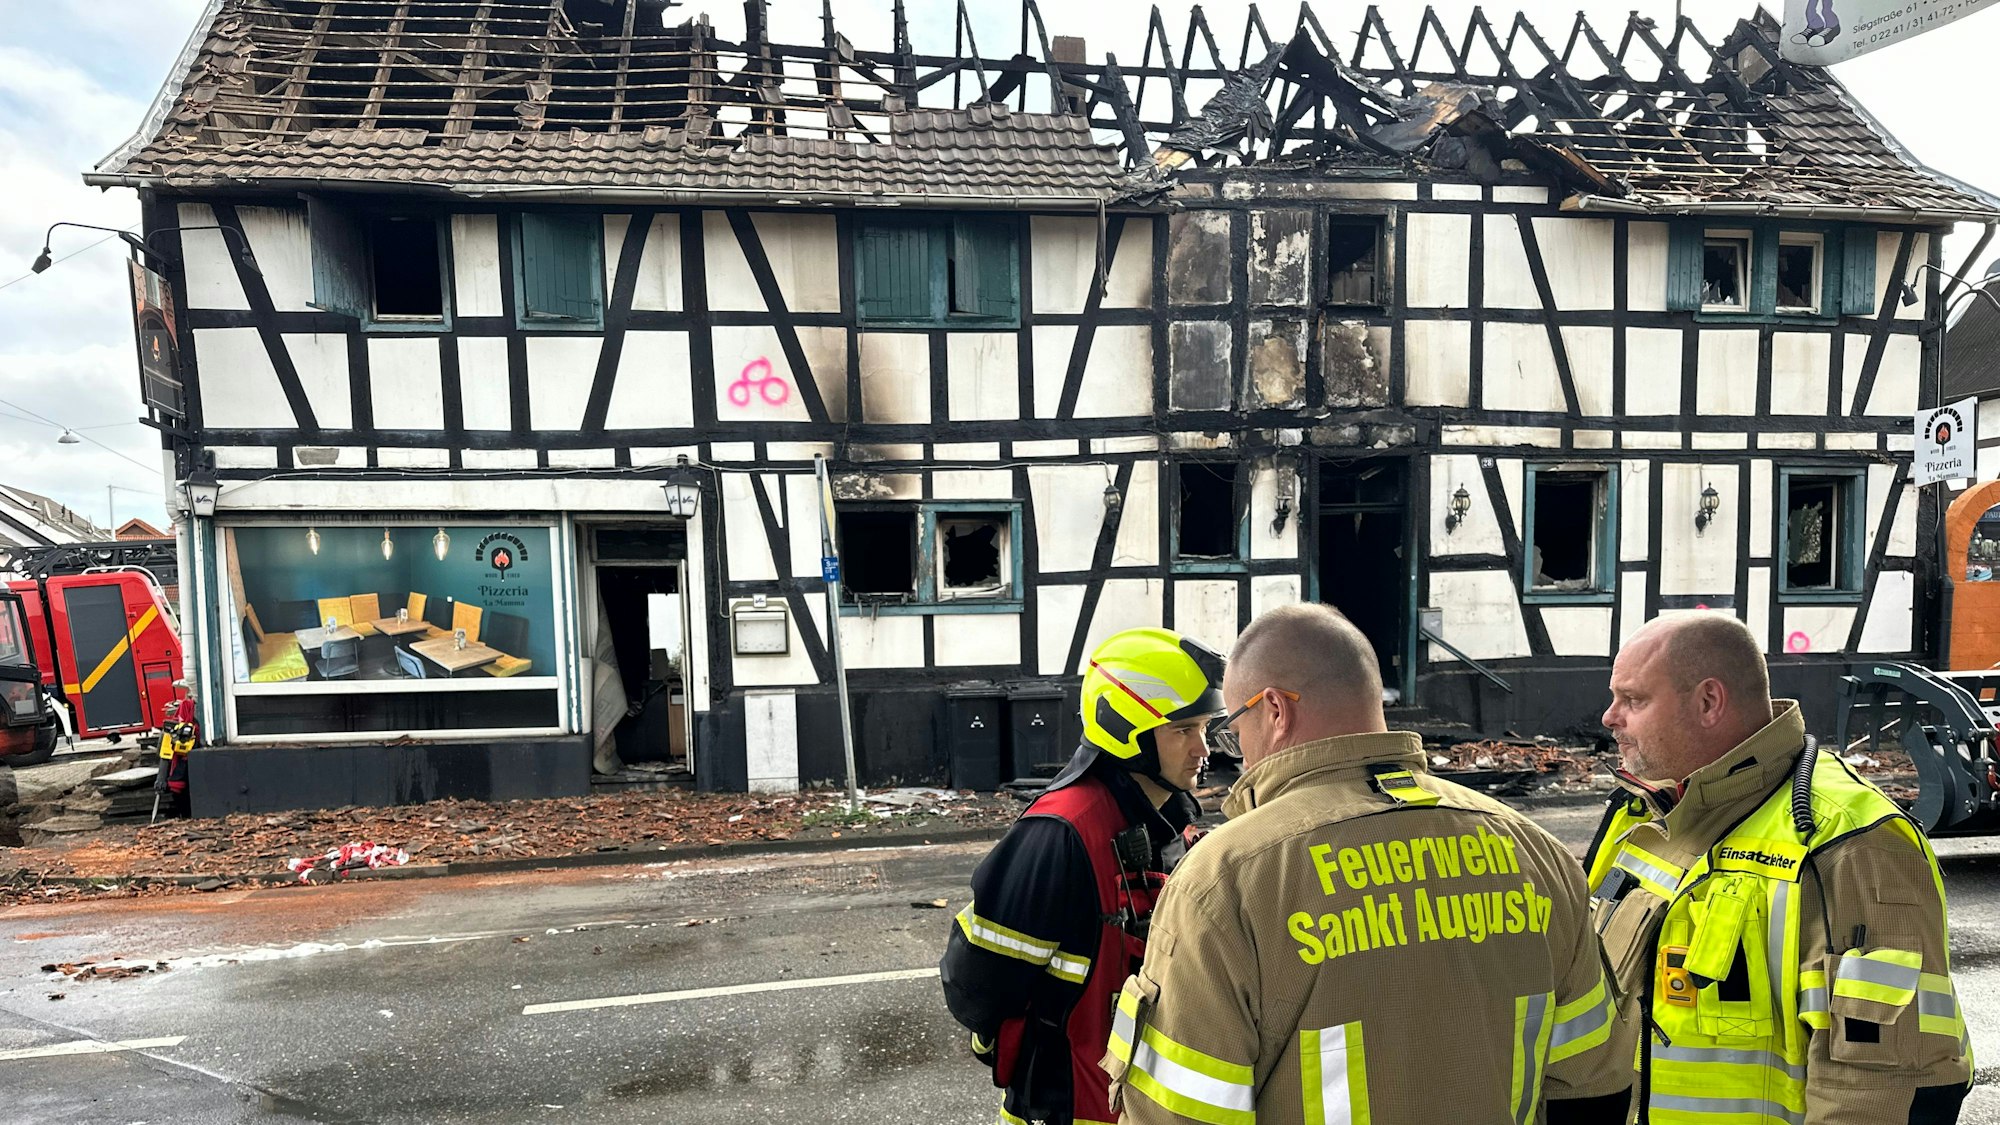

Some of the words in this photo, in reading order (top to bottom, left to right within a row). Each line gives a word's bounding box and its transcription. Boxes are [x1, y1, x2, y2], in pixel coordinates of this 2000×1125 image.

[1853, 10, 1903, 34] Siegstraße
[1906, 2, 1917, 14] 61
[1853, 38, 1868, 49] Tel.
[1925, 457, 1962, 473] Pizzeria
[1984, 511, 2000, 519] PAU
[477, 585, 529, 596] Pizzeria
[1309, 825, 1520, 896] Feuerwehr
[1718, 847, 1797, 869] Einsatzleiter
[1287, 892, 1407, 965] Sankt
